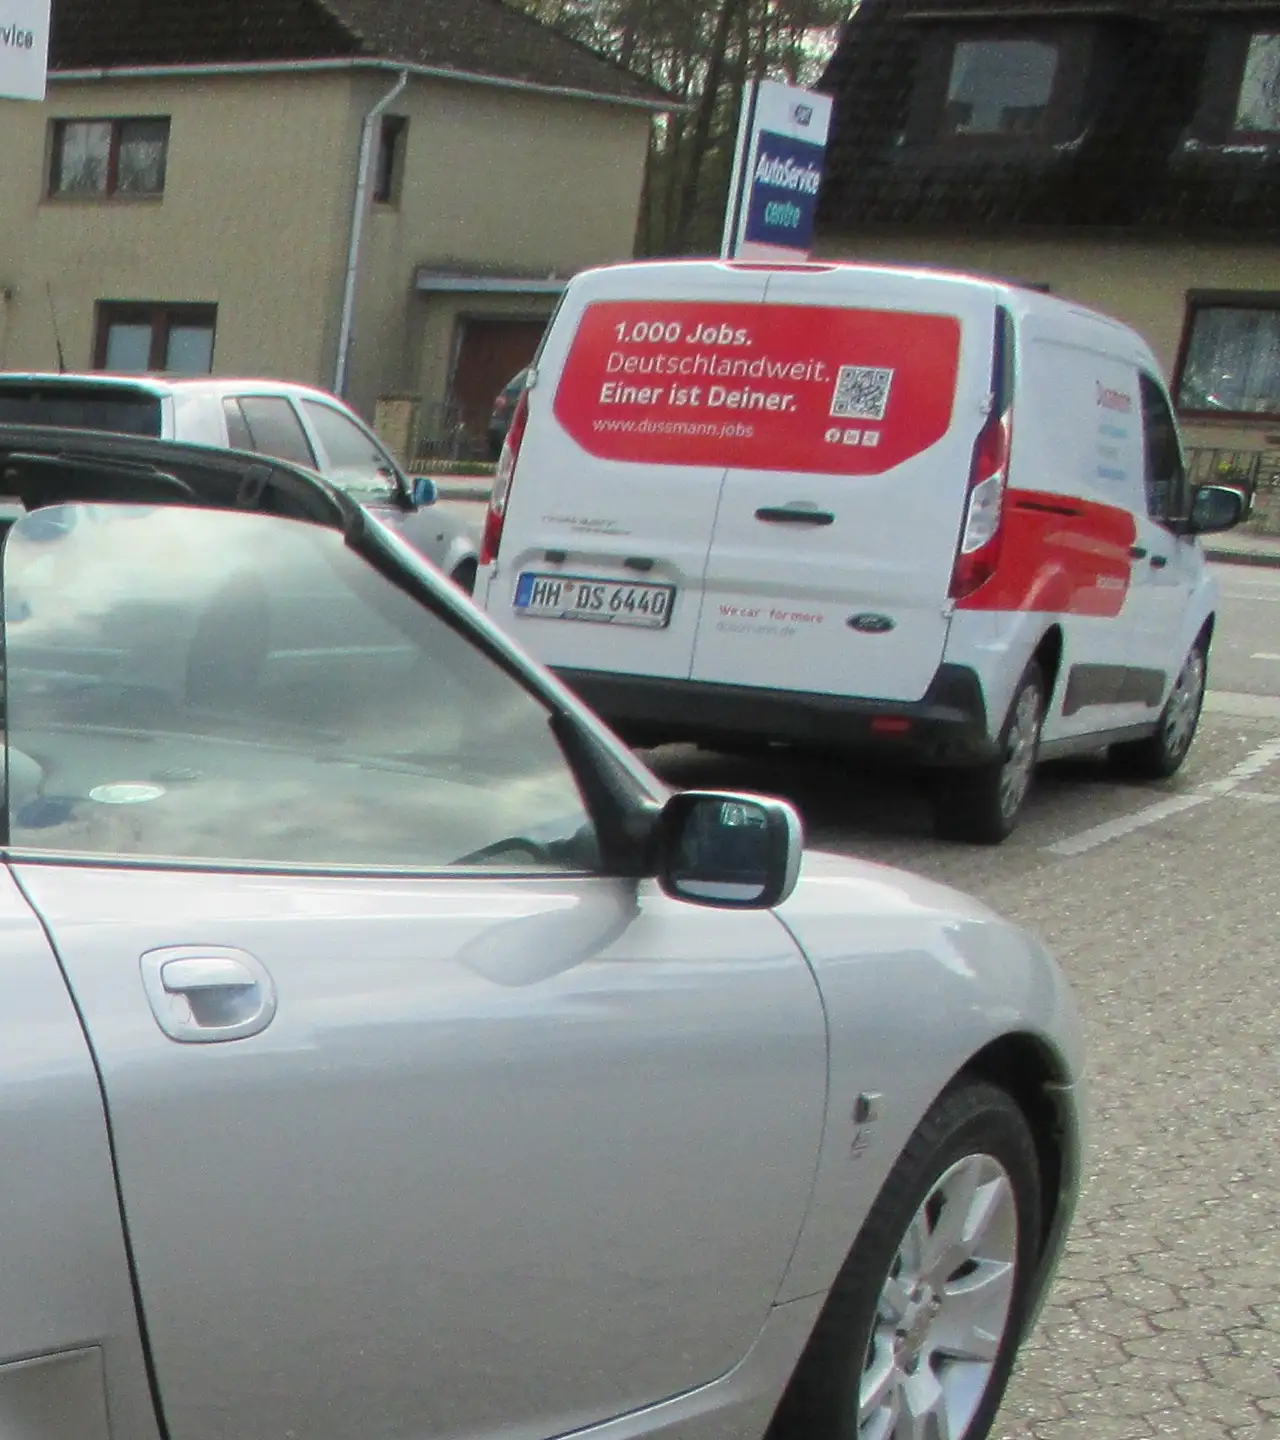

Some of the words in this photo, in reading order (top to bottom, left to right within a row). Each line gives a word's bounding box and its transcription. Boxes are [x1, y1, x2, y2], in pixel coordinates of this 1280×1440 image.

[755, 152, 821, 195] AutoService
[614, 322, 681, 343] 1.000
[686, 323, 753, 347] Jobs.
[606, 351, 832, 382] Deutschlandweit.
[599, 382, 664, 405] Einer
[668, 384, 701, 406] ist
[707, 385, 797, 412] Deiner.
[592, 418, 754, 439] www.dussmann.jobs
[531, 581, 562, 606] HH
[575, 585, 605, 610] DS
[610, 587, 667, 616] 6440
[789, 612, 825, 624] more
